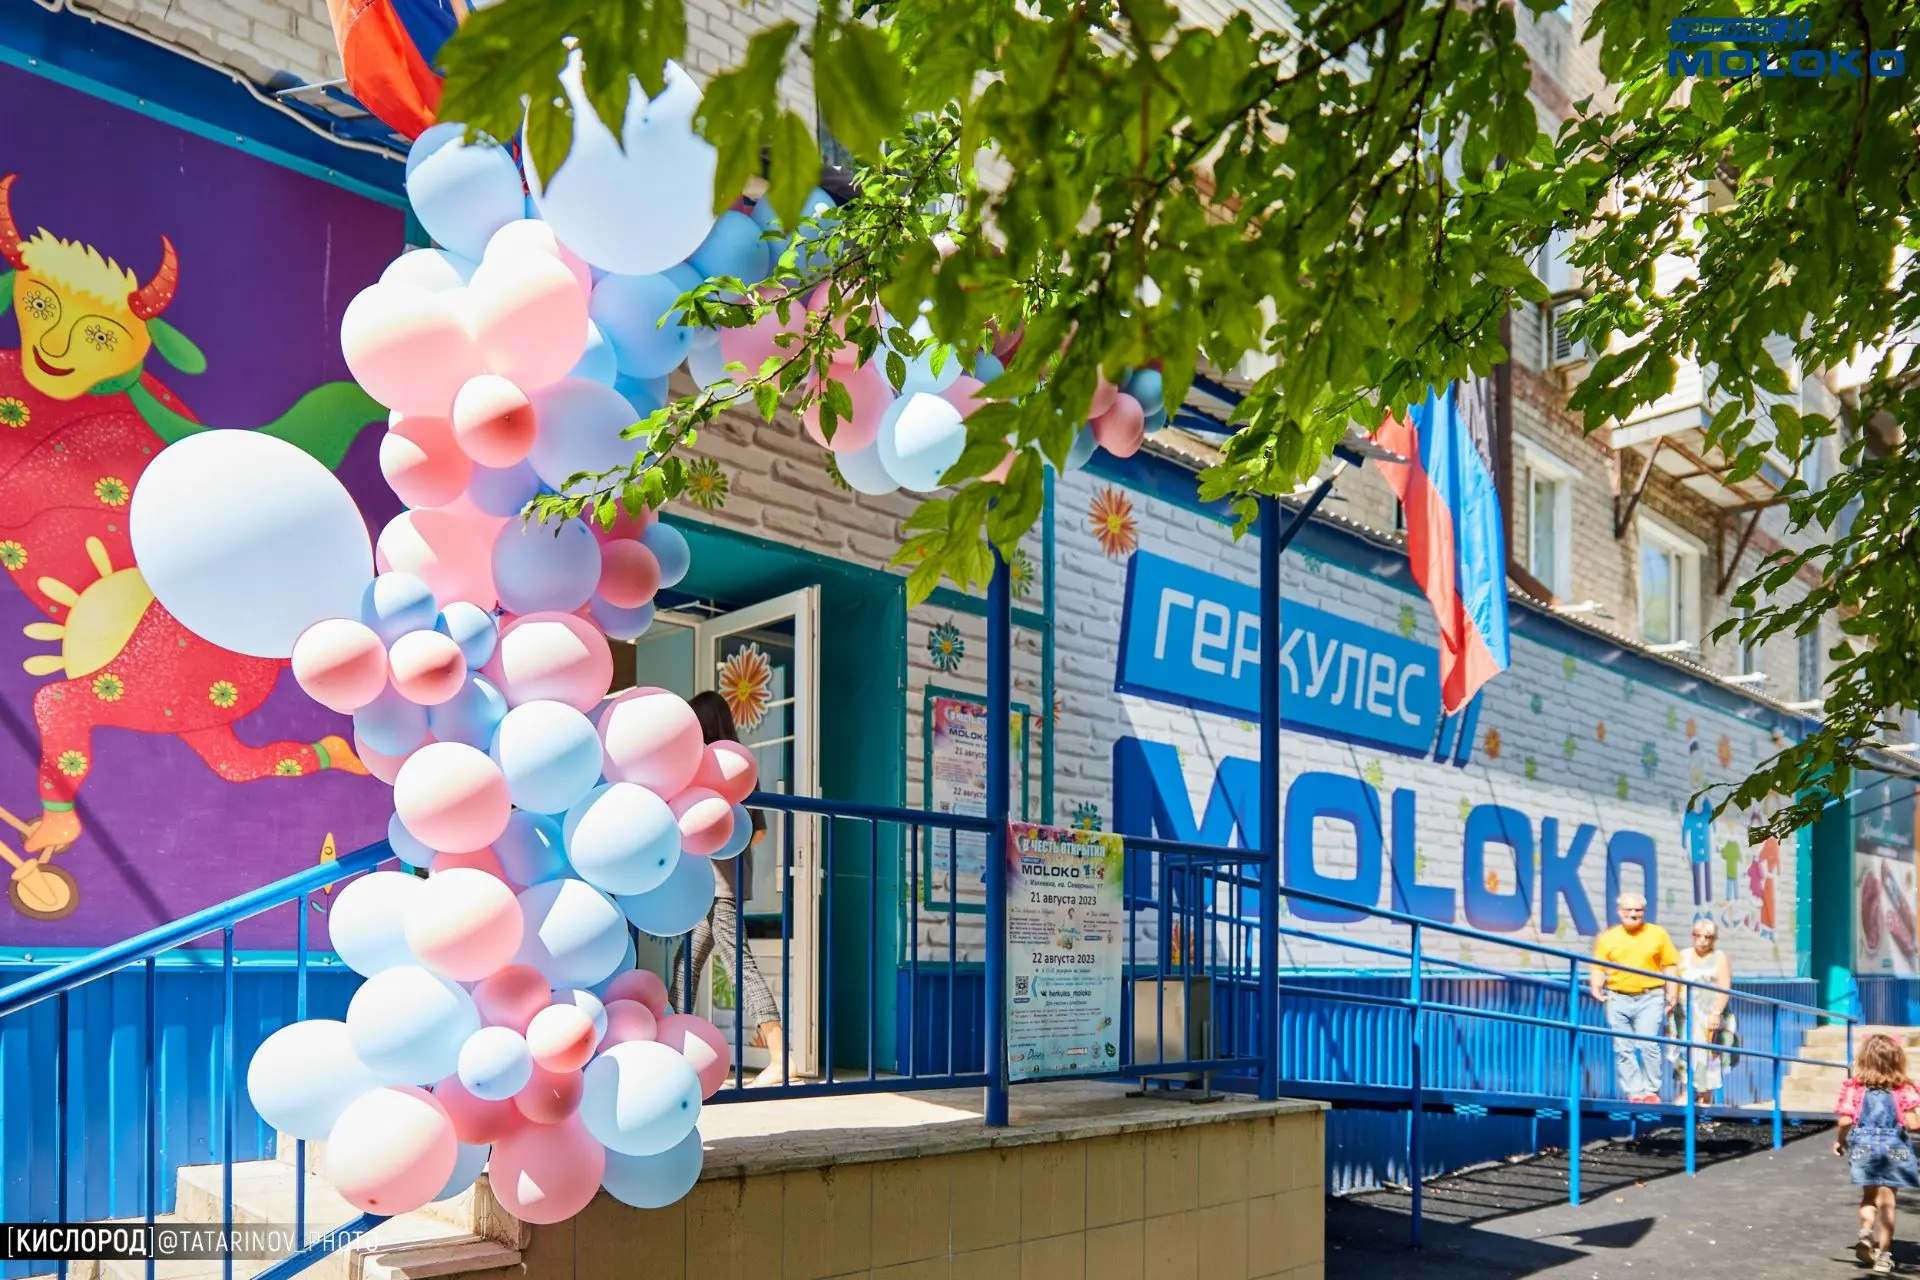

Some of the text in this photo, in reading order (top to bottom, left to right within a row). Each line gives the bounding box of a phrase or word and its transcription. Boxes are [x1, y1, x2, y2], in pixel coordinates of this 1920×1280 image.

[1112, 735, 1658, 937] MOLOKO
[1023, 840, 1105, 856] В ЧЕСТЬ ОТКРЫТИЯ
[1022, 864, 1080, 878] MOLOKO
[1030, 891, 1097, 906] 21 августа 2023
[1032, 952, 1095, 966] 22 августа 2023
